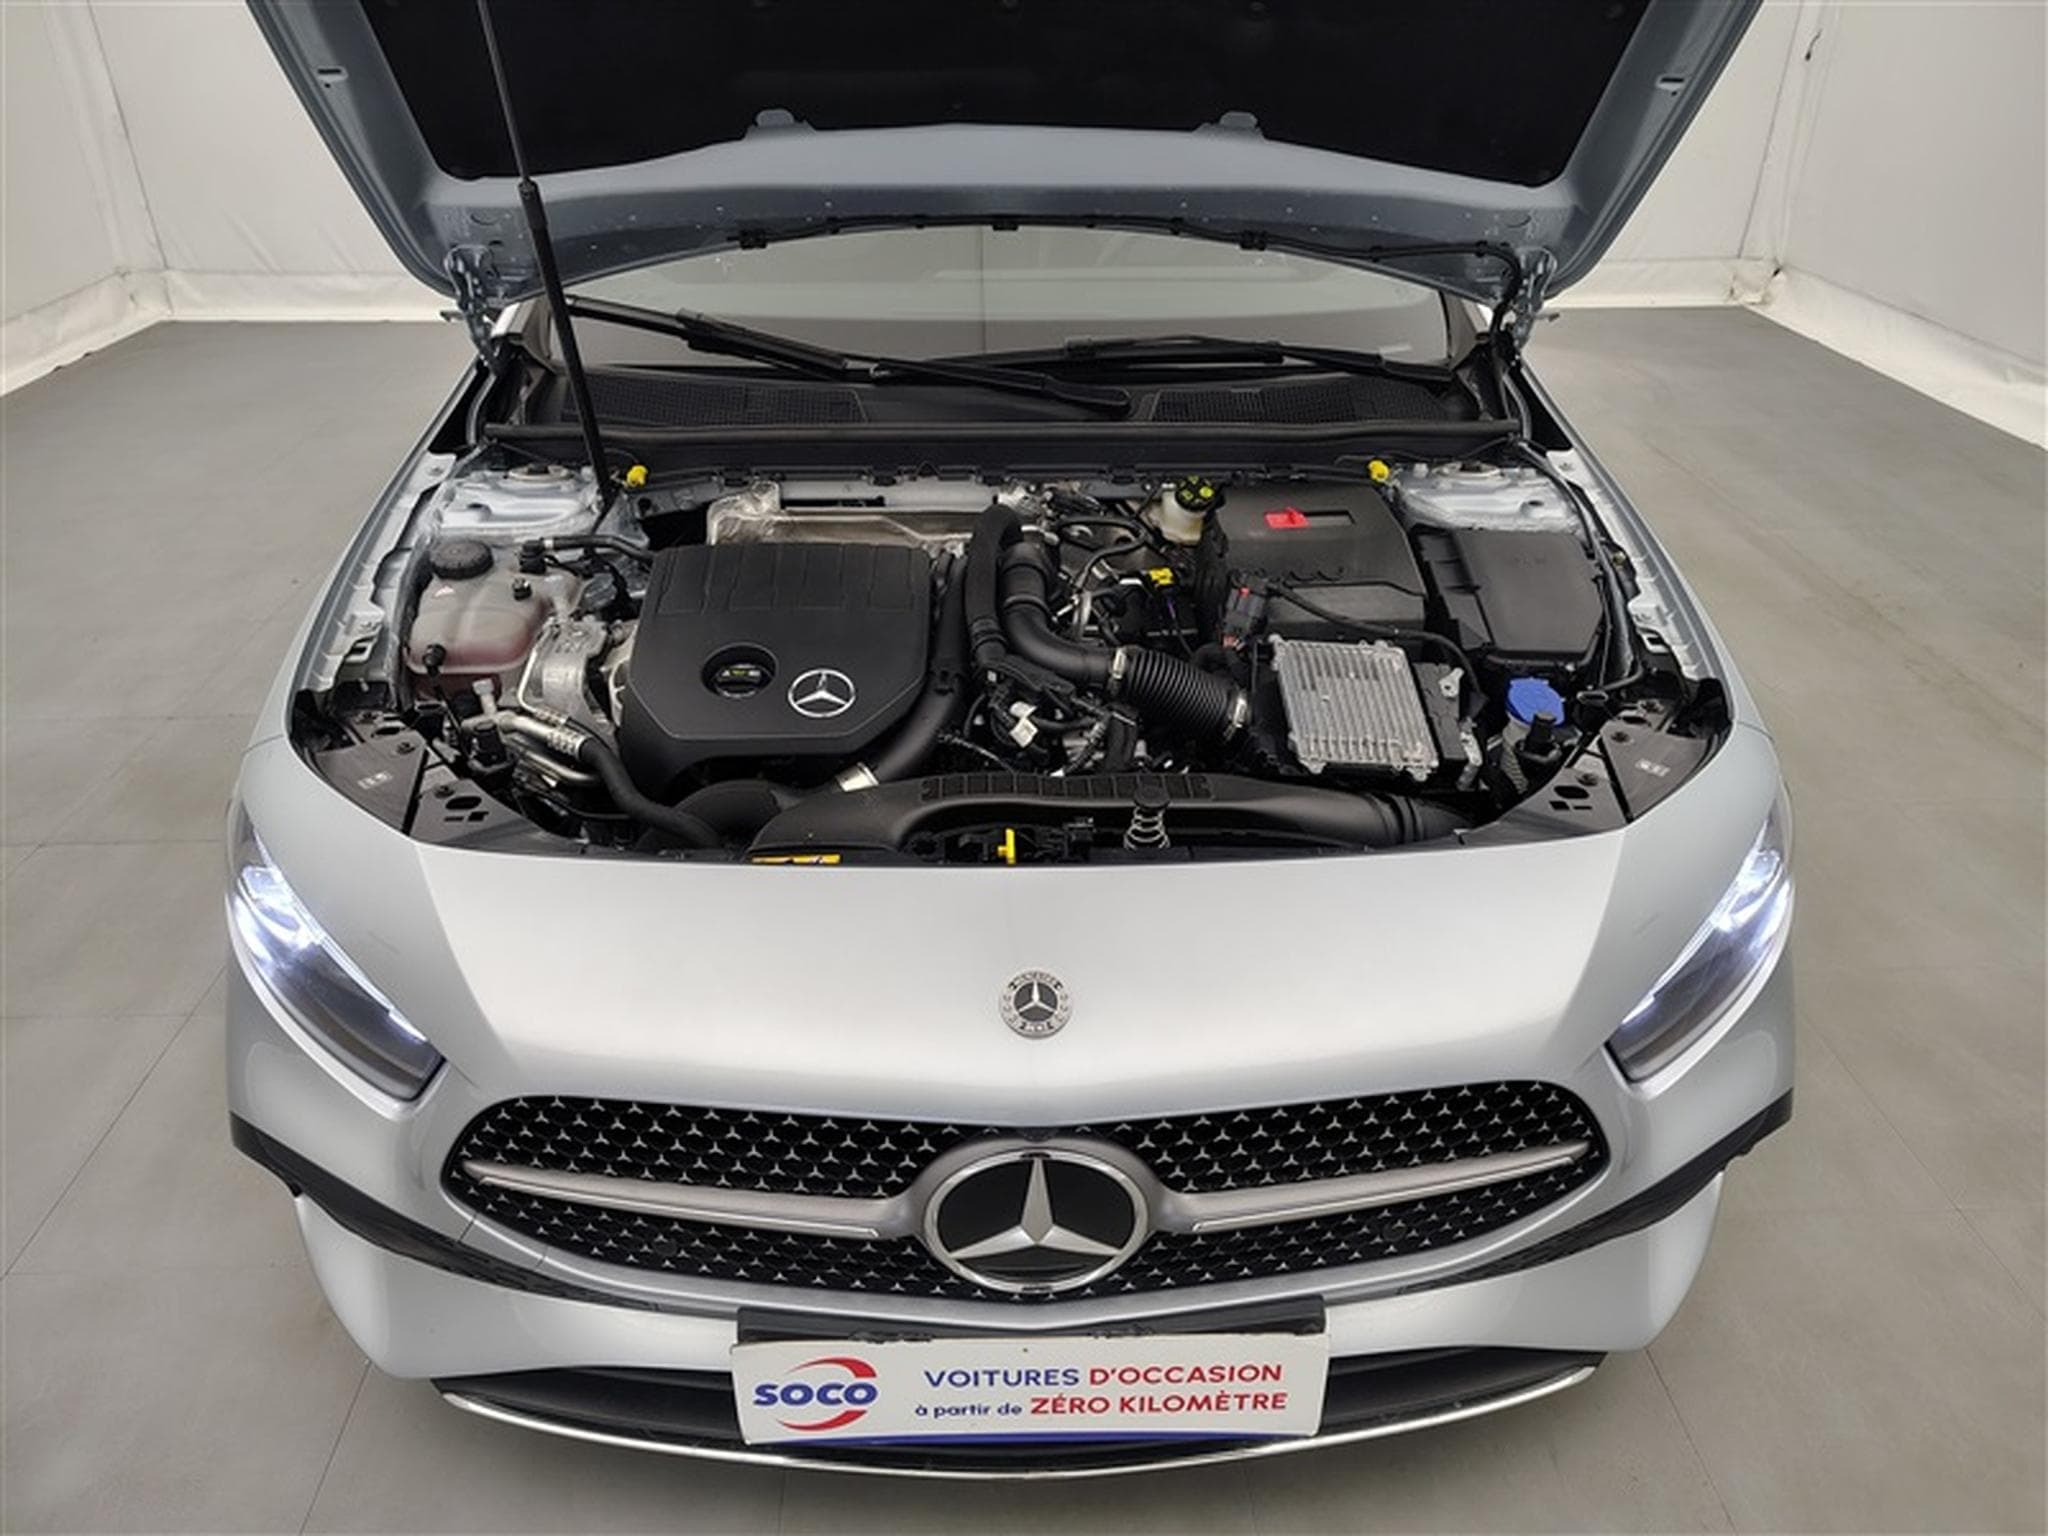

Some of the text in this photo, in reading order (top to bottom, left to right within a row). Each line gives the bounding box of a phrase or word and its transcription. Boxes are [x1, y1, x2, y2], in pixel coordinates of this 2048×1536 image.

[924, 1365, 1282, 1388] VOITURES D'OCCASION
[753, 1382, 878, 1406] SOCO
[915, 1390, 1288, 1419] à partir de ZÉRO KILOMÈTRE
